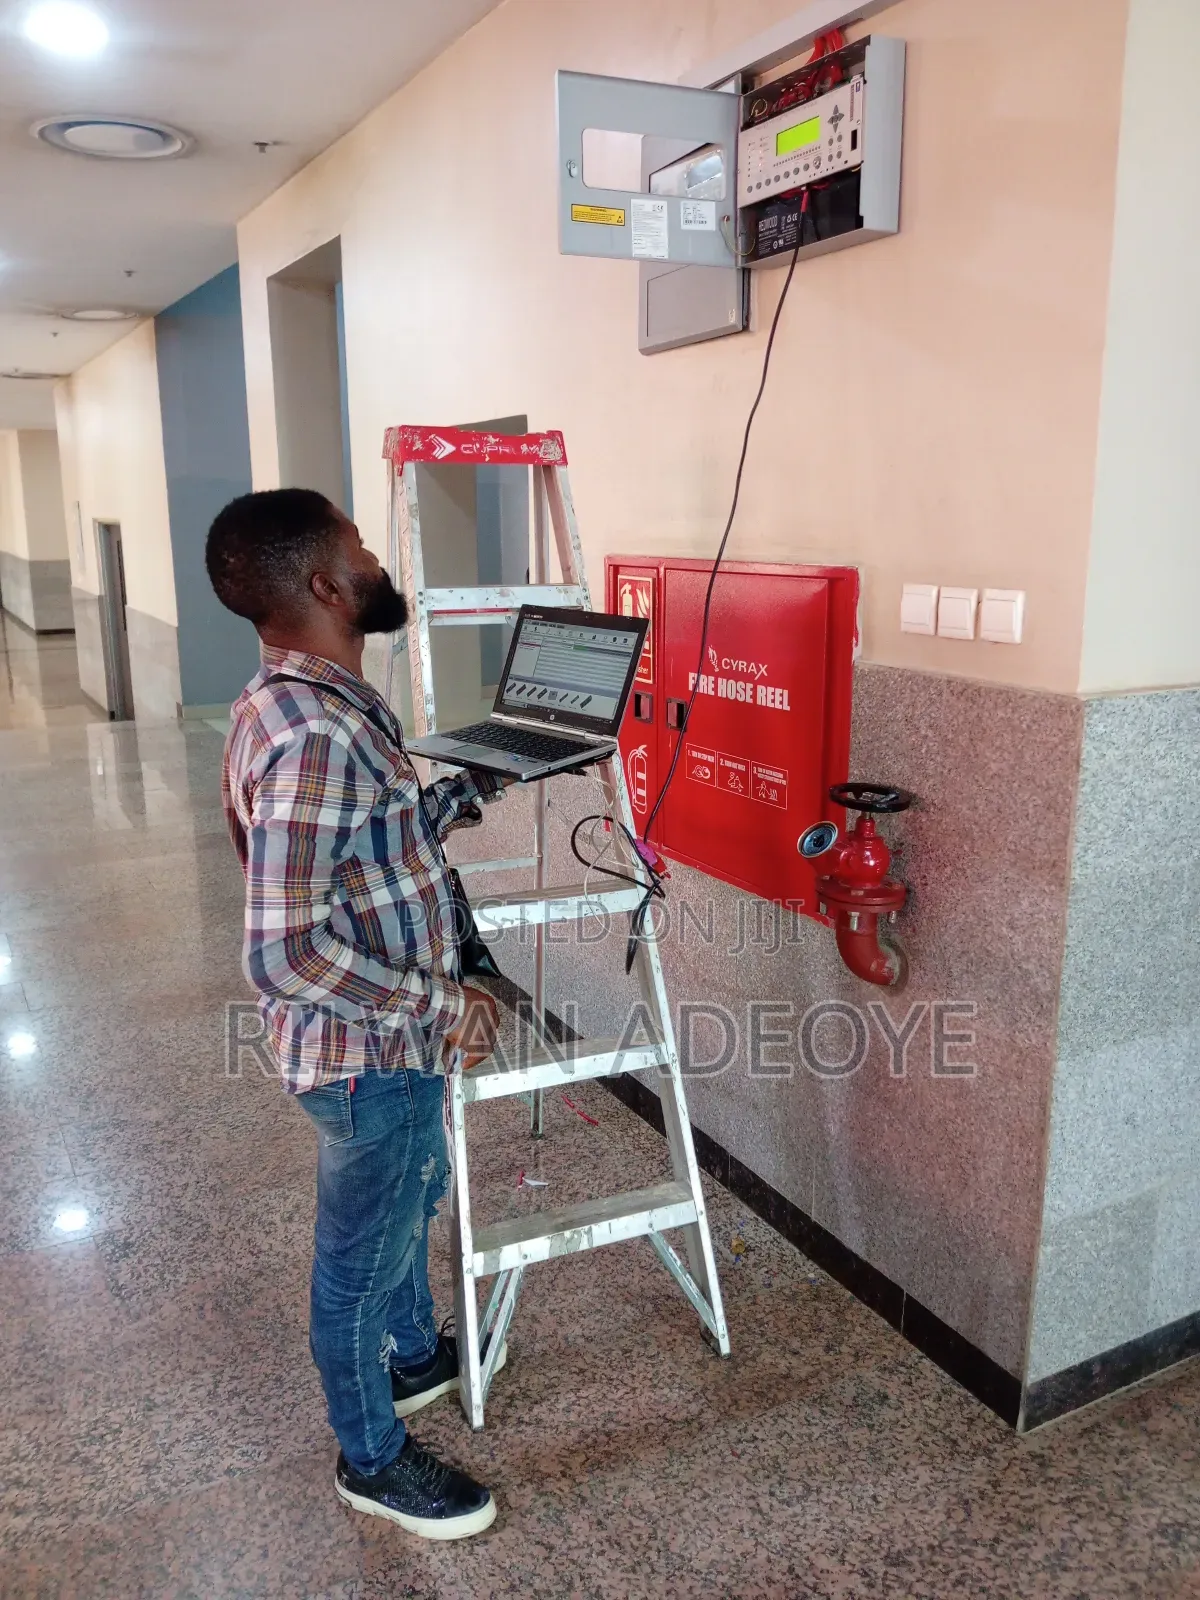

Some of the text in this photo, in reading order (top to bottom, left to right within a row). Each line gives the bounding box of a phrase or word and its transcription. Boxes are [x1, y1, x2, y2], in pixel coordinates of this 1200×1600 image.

[721, 657, 768, 681] CYRAX
[717, 677, 753, 704] HOSE
[756, 684, 791, 711] REEL
